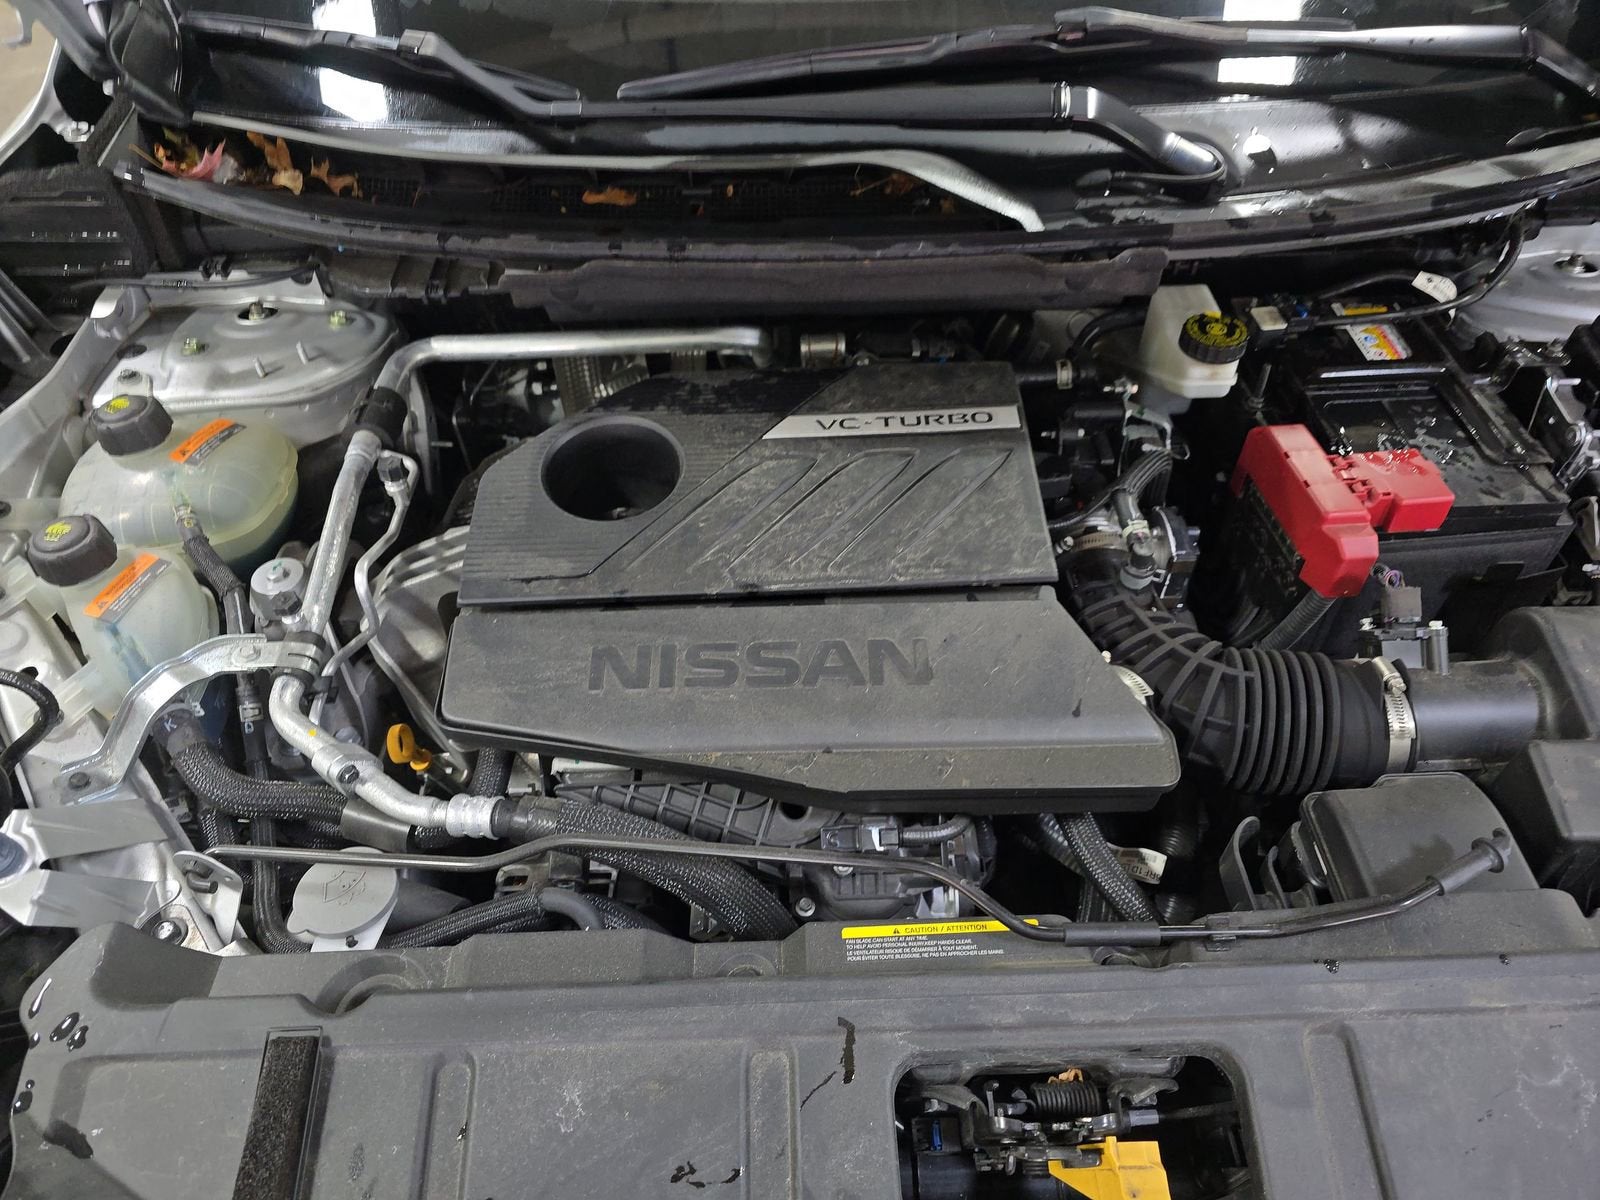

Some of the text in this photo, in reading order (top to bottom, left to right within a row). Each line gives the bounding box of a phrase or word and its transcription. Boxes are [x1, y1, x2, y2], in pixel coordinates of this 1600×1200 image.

[816, 411, 994, 431] VC-TURBO
[588, 637, 934, 694] NISSAN
[904, 926, 938, 934] CAUTION
[946, 924, 988, 932] ATTENTION
